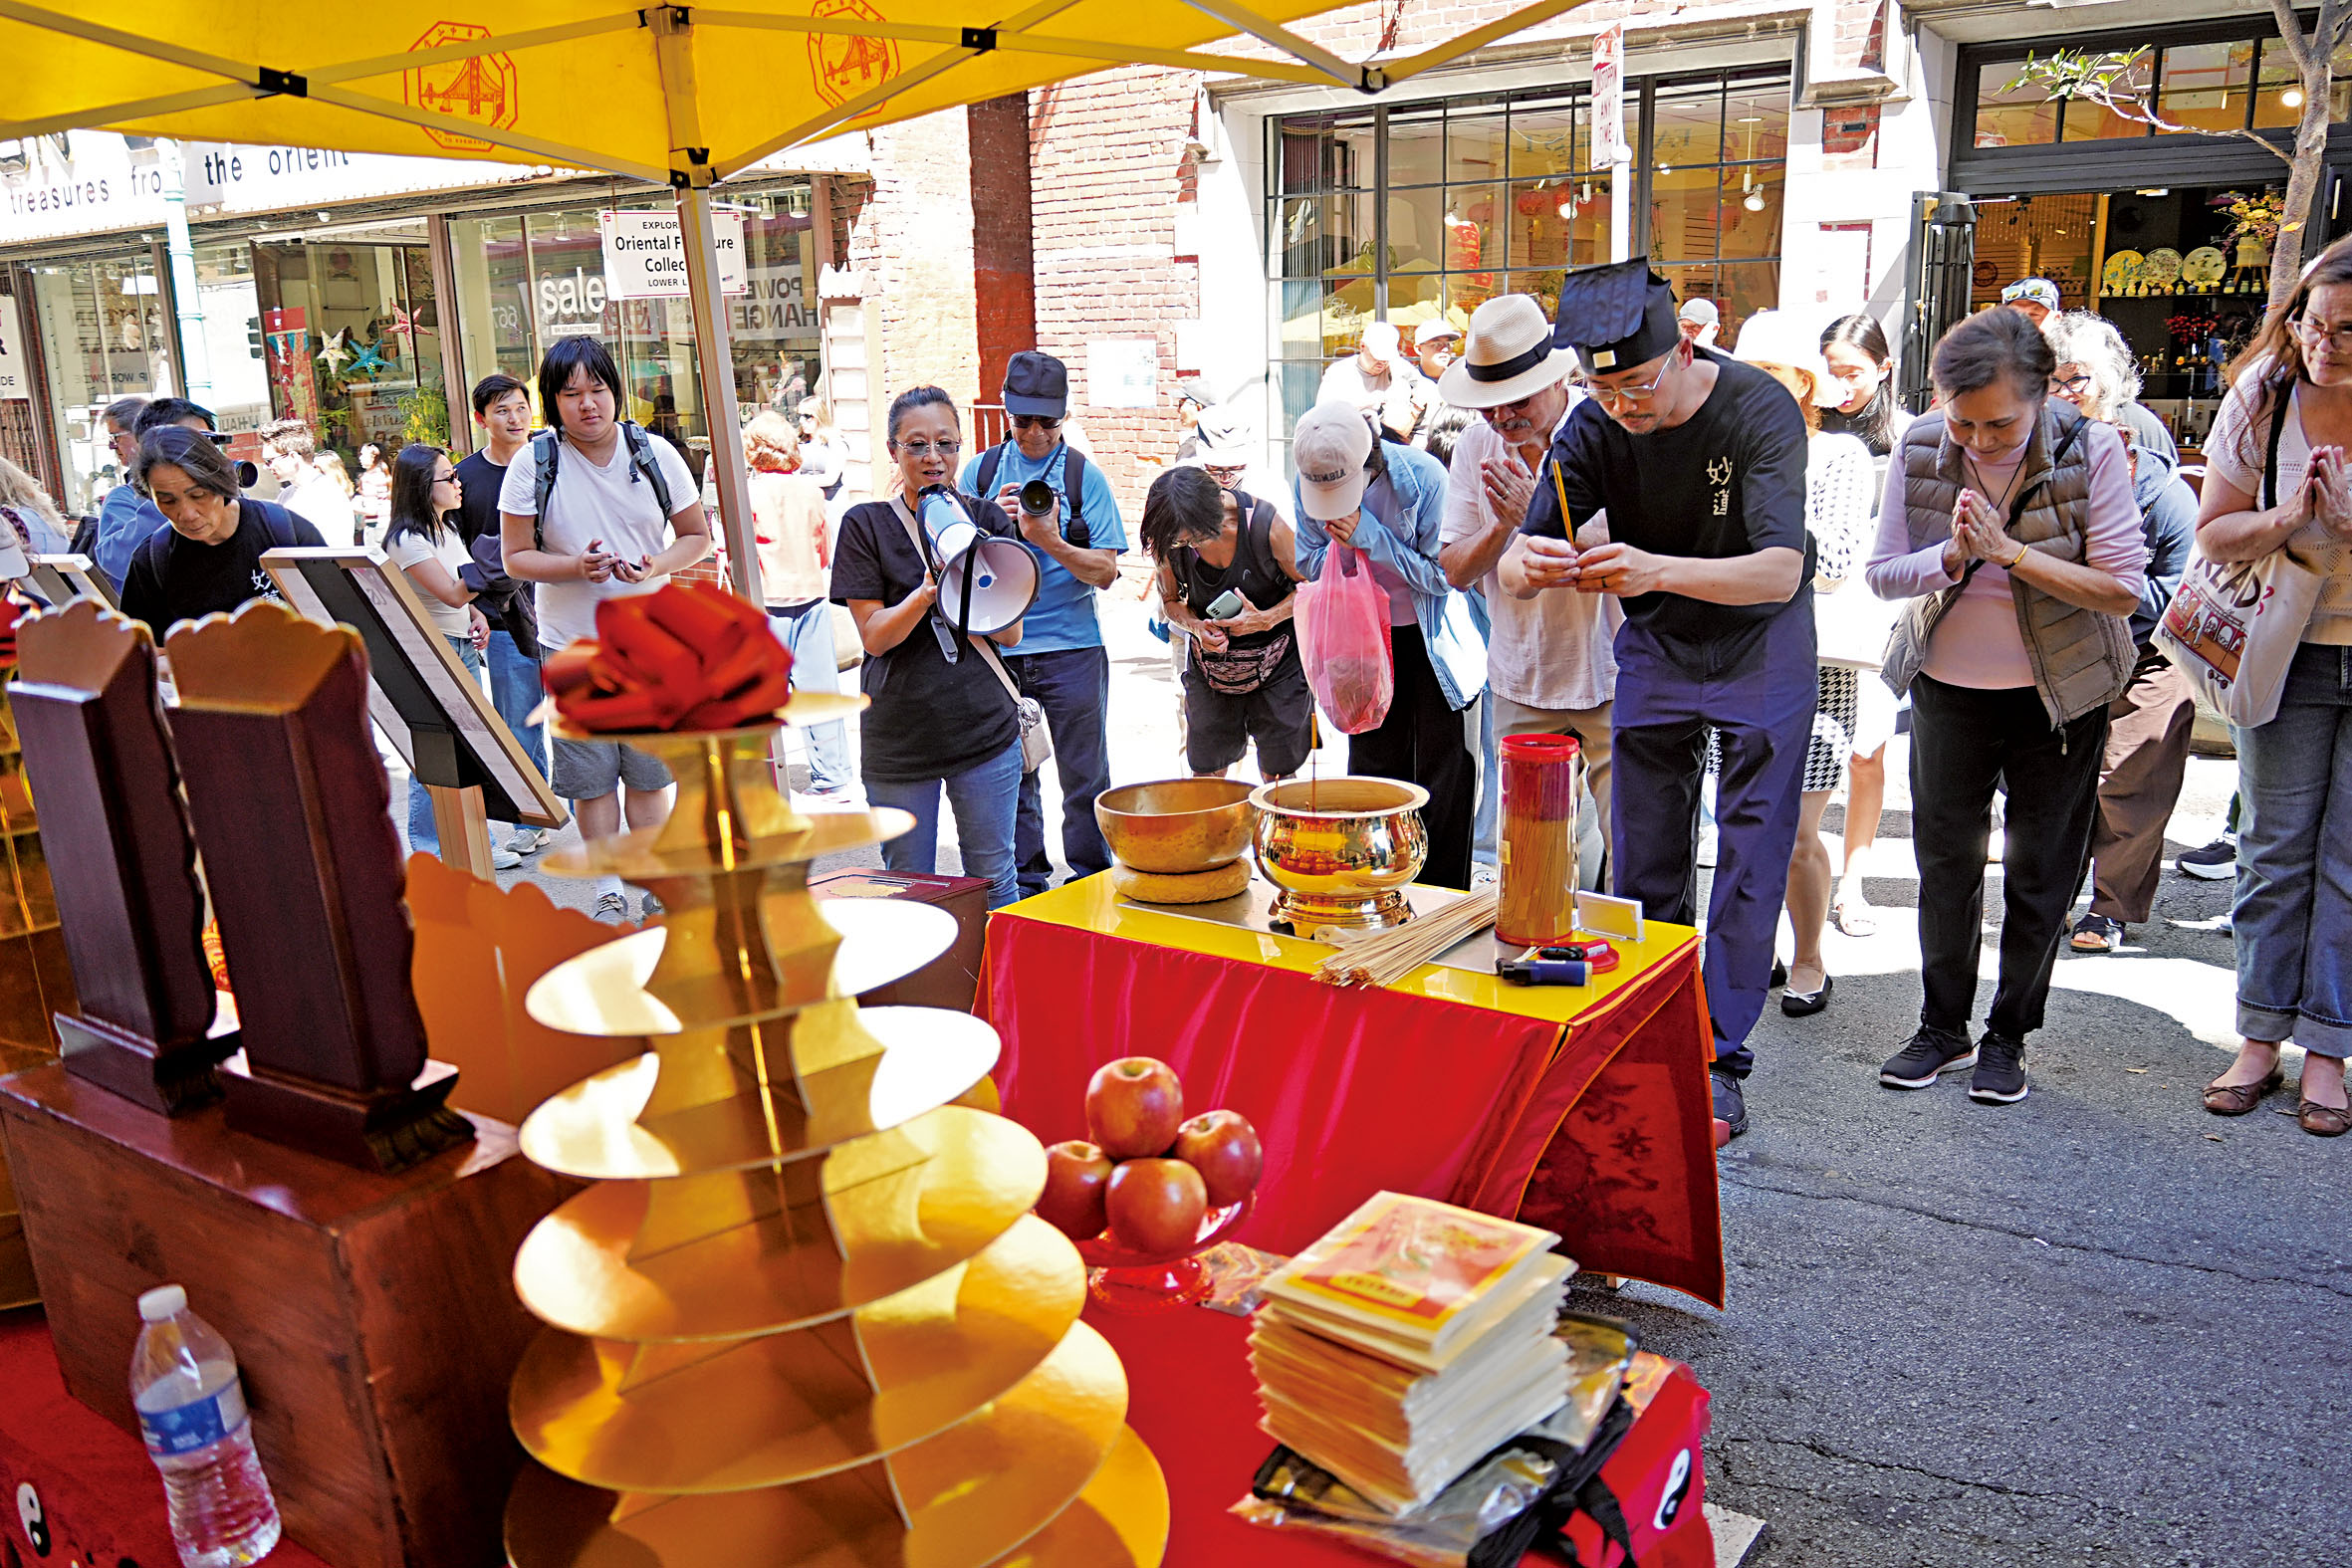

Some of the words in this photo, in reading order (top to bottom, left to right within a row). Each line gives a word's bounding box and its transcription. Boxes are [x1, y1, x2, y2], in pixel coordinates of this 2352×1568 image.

[10, 179, 110, 215] treasures
[131, 165, 161, 196] fro
[205, 151, 242, 186] the
[642, 221, 678, 230] EXPLOR
[615, 235, 671, 251] Oriental
[645, 257, 685, 272] Collec
[647, 279, 678, 288] LOWER
[541, 267, 606, 316] sale
